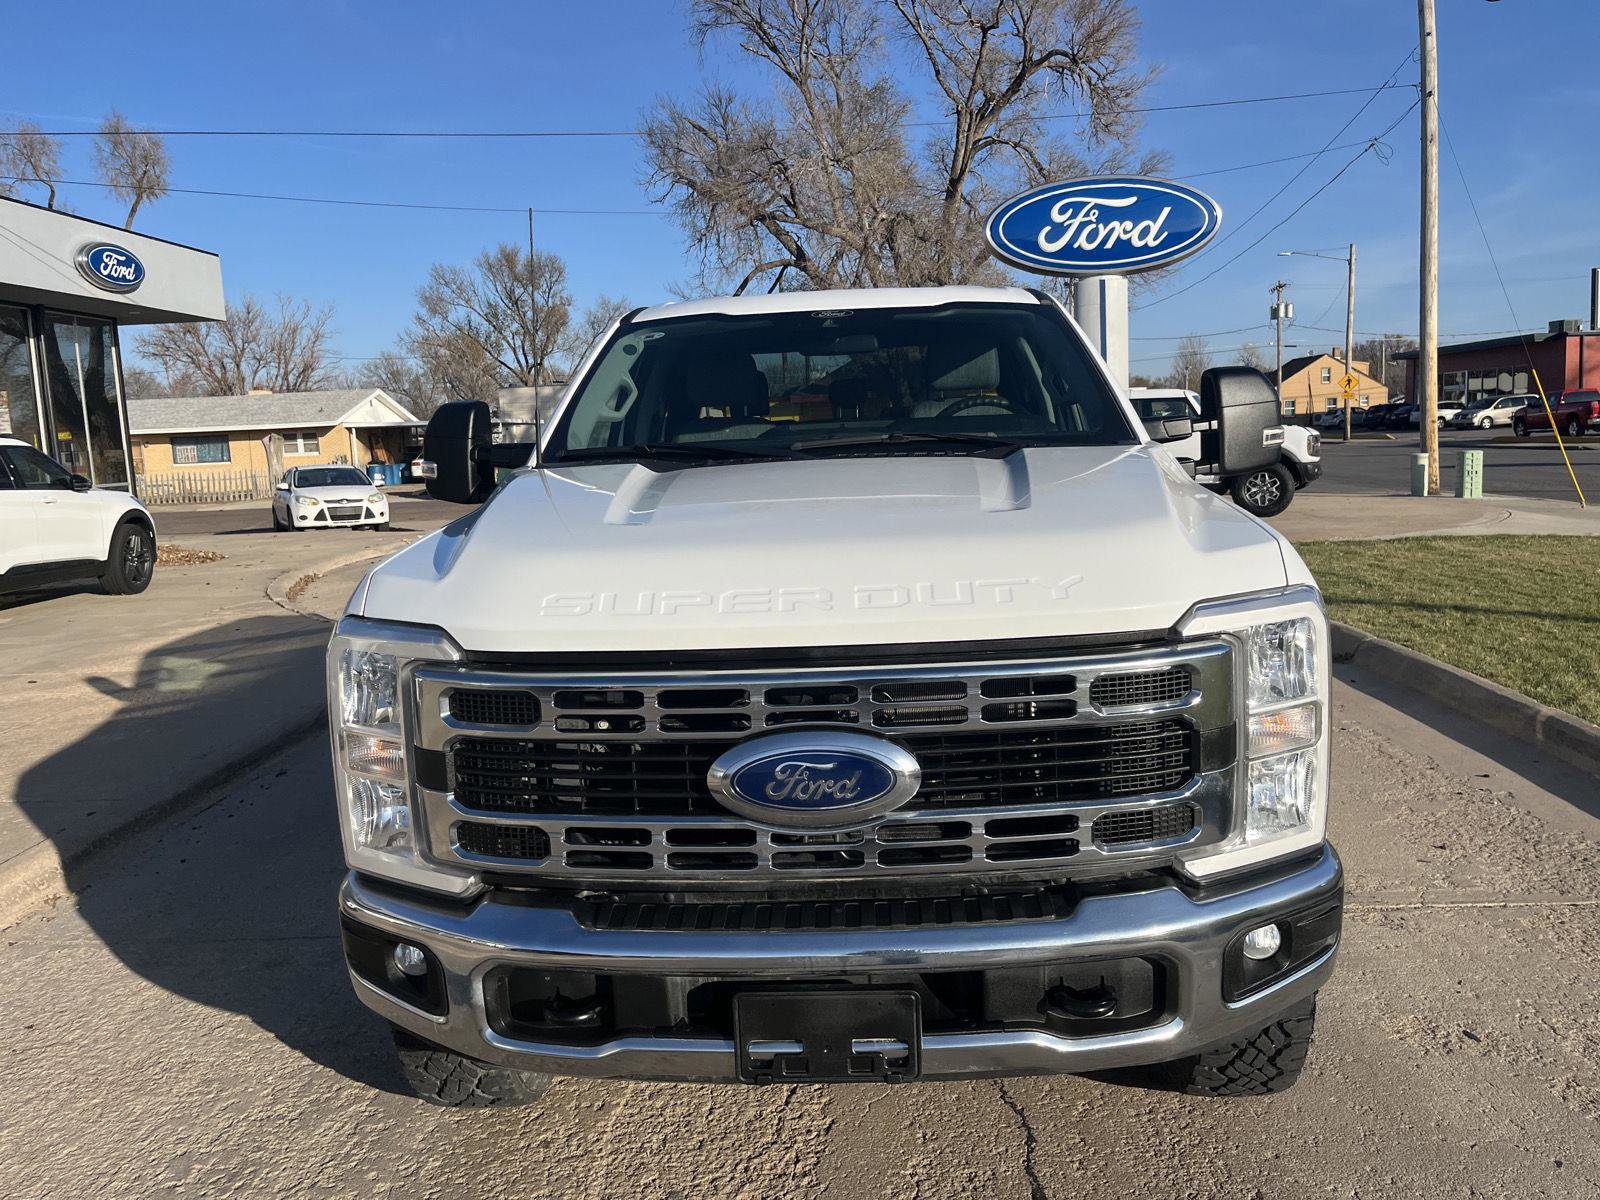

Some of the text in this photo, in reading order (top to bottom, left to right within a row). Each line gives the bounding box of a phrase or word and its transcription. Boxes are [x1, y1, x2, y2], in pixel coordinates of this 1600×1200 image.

[1038, 196, 1171, 252] Ford
[100, 251, 136, 280] Ford
[539, 574, 1084, 616] SUPER DUTY
[765, 761, 862, 801] Ford
